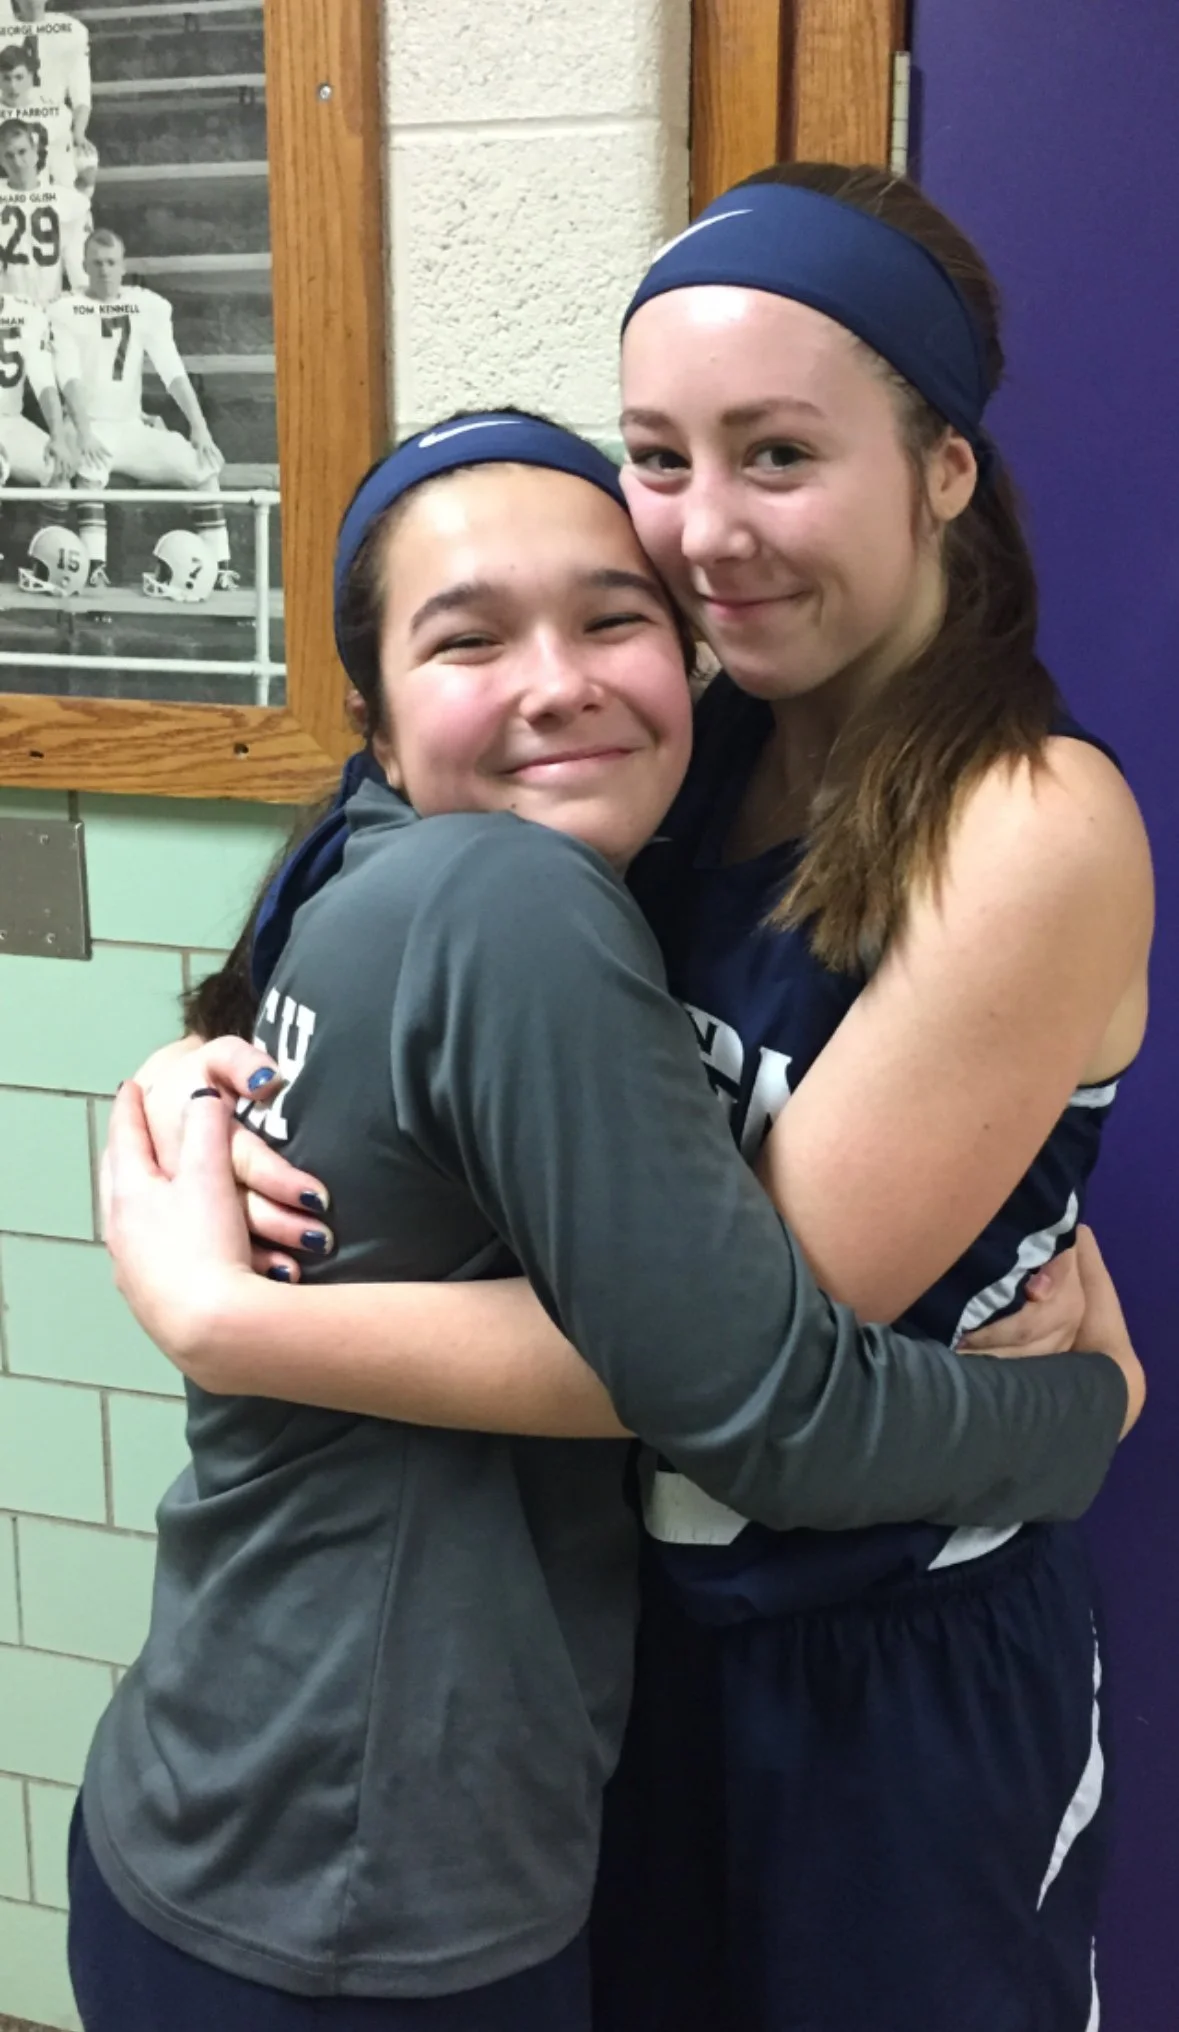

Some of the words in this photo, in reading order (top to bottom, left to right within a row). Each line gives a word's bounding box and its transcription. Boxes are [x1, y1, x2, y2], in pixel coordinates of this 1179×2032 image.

[36, 23, 72, 33] MOORE
[16, 107, 60, 118] PARROTT
[1, 205, 60, 267] 29
[72, 305, 95, 315] TOM
[99, 304, 140, 314] KENNELL
[101, 314, 131, 381] 7
[56, 548, 81, 573] 15
